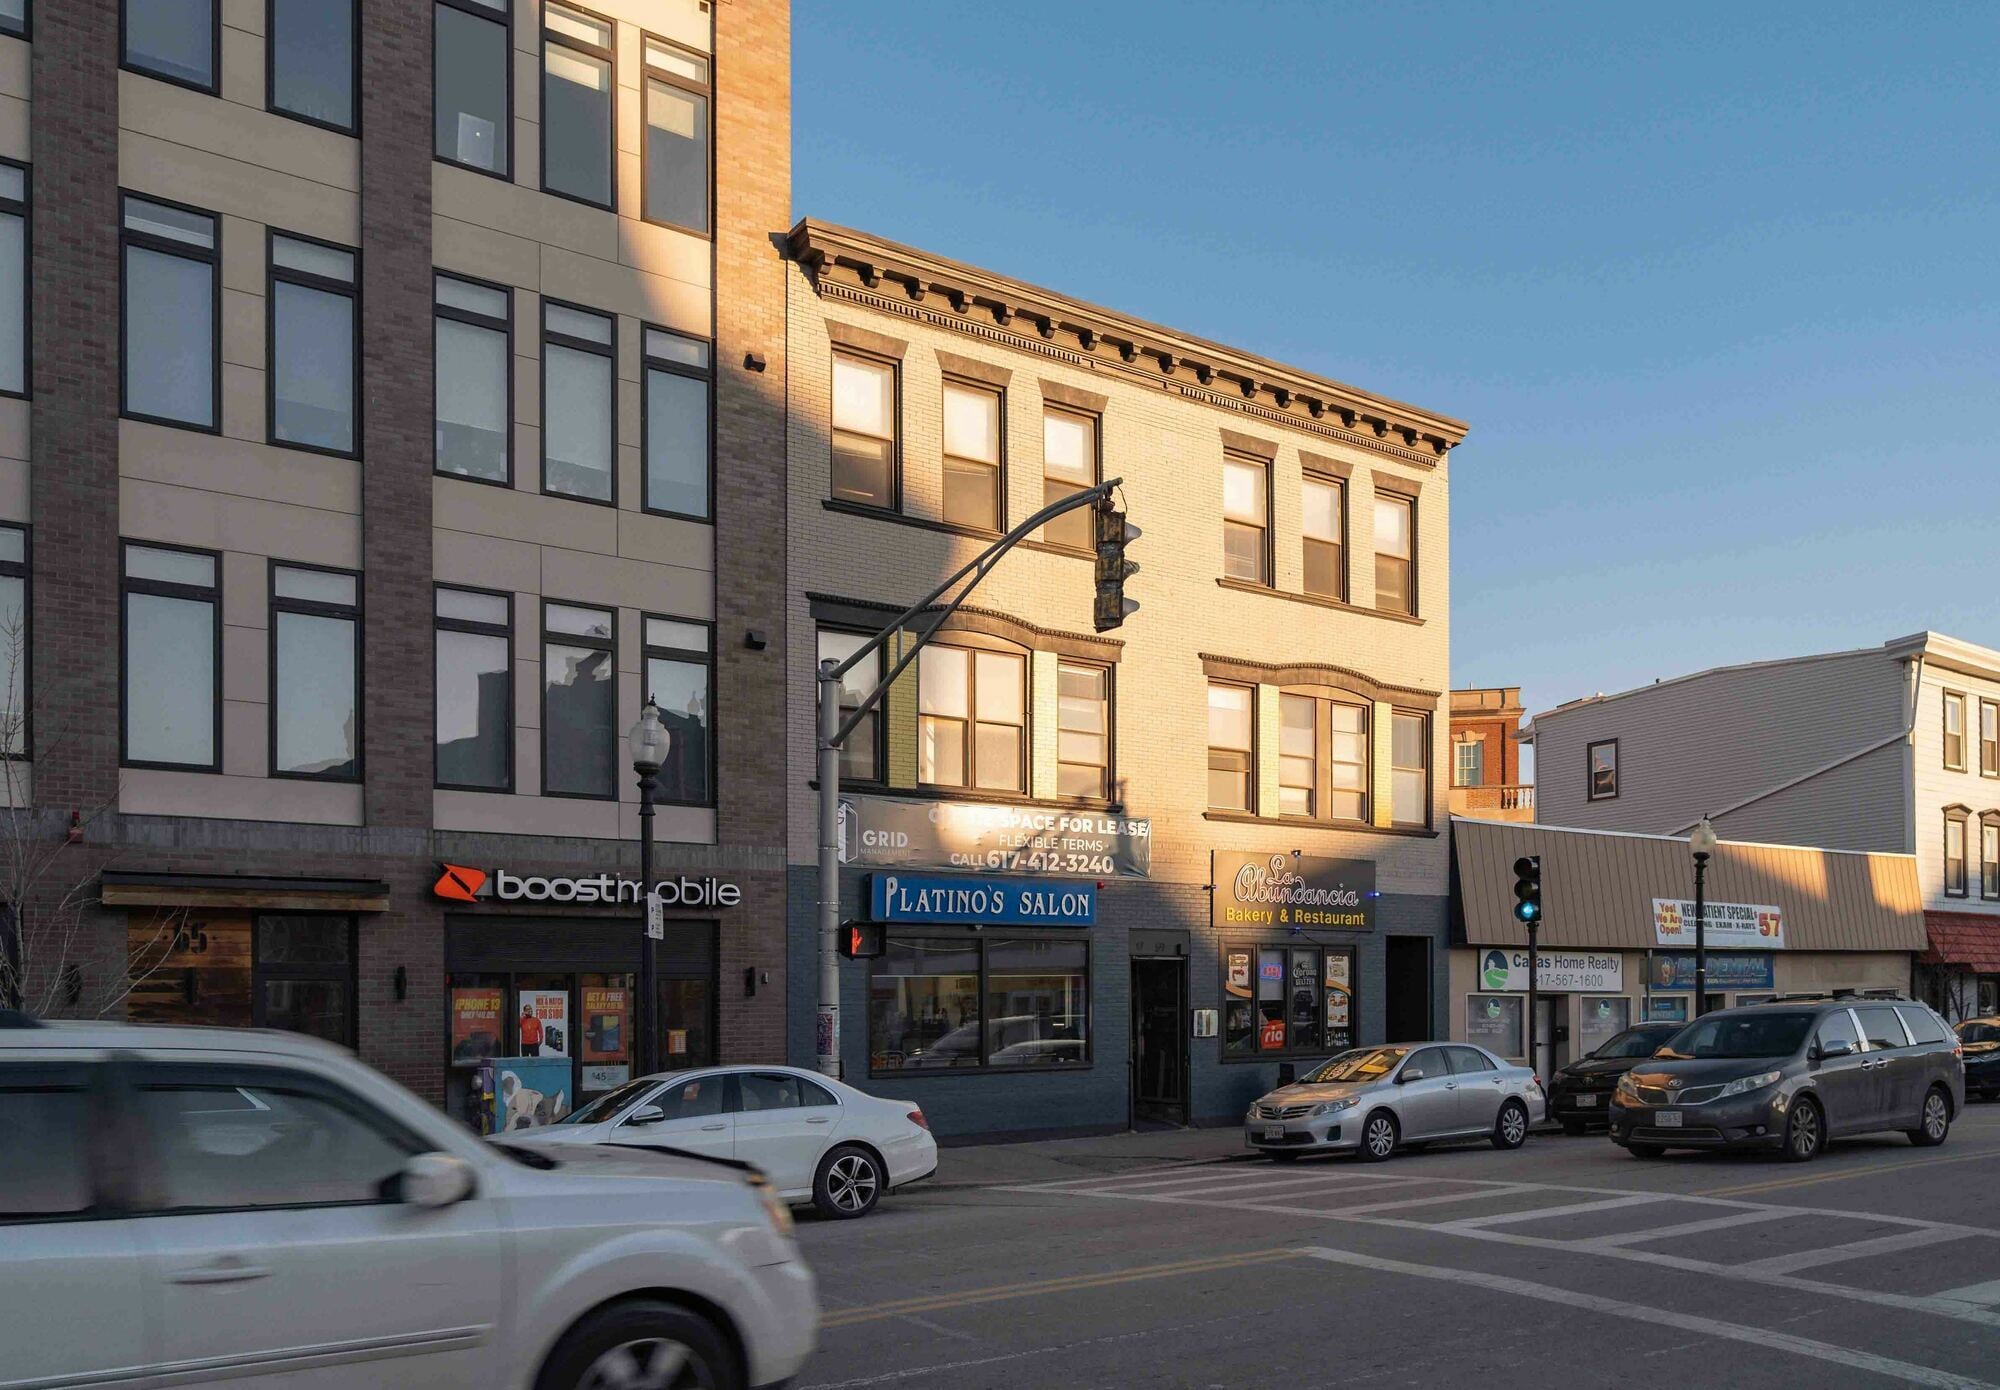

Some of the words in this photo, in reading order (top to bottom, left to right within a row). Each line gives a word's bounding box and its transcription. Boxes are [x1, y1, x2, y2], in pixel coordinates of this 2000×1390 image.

[1000, 813, 1055, 831] SPACE
[1060, 817, 1093, 833] FOR
[1098, 820, 1148, 837] LEASE
[862, 830, 908, 847] GRID
[1000, 835, 1058, 850] FLEXIBLE
[1062, 838, 1103, 851] TERMS
[950, 853, 985, 867] CALL
[986, 850, 1114, 873] 617-412-3240
[1266, 854, 1295, 885] La
[1234, 862, 1359, 907] Abundancia
[1019, 891, 1090, 916] SALON
[1659, 902, 1676, 913] Yes!
[1703, 905, 1725, 919] ATIENT
[1727, 906, 1755, 920] SPECIAL
[1226, 907, 1273, 925] Bakery
[1280, 909, 1289, 923] &
[1295, 909, 1365, 926] Restaurant
[1660, 924, 1682, 936] Open!
[1554, 955, 1584, 969] Home
[1587, 956, 1619, 973] Realty
[1536, 974, 1603, 987] 17-567-1600
